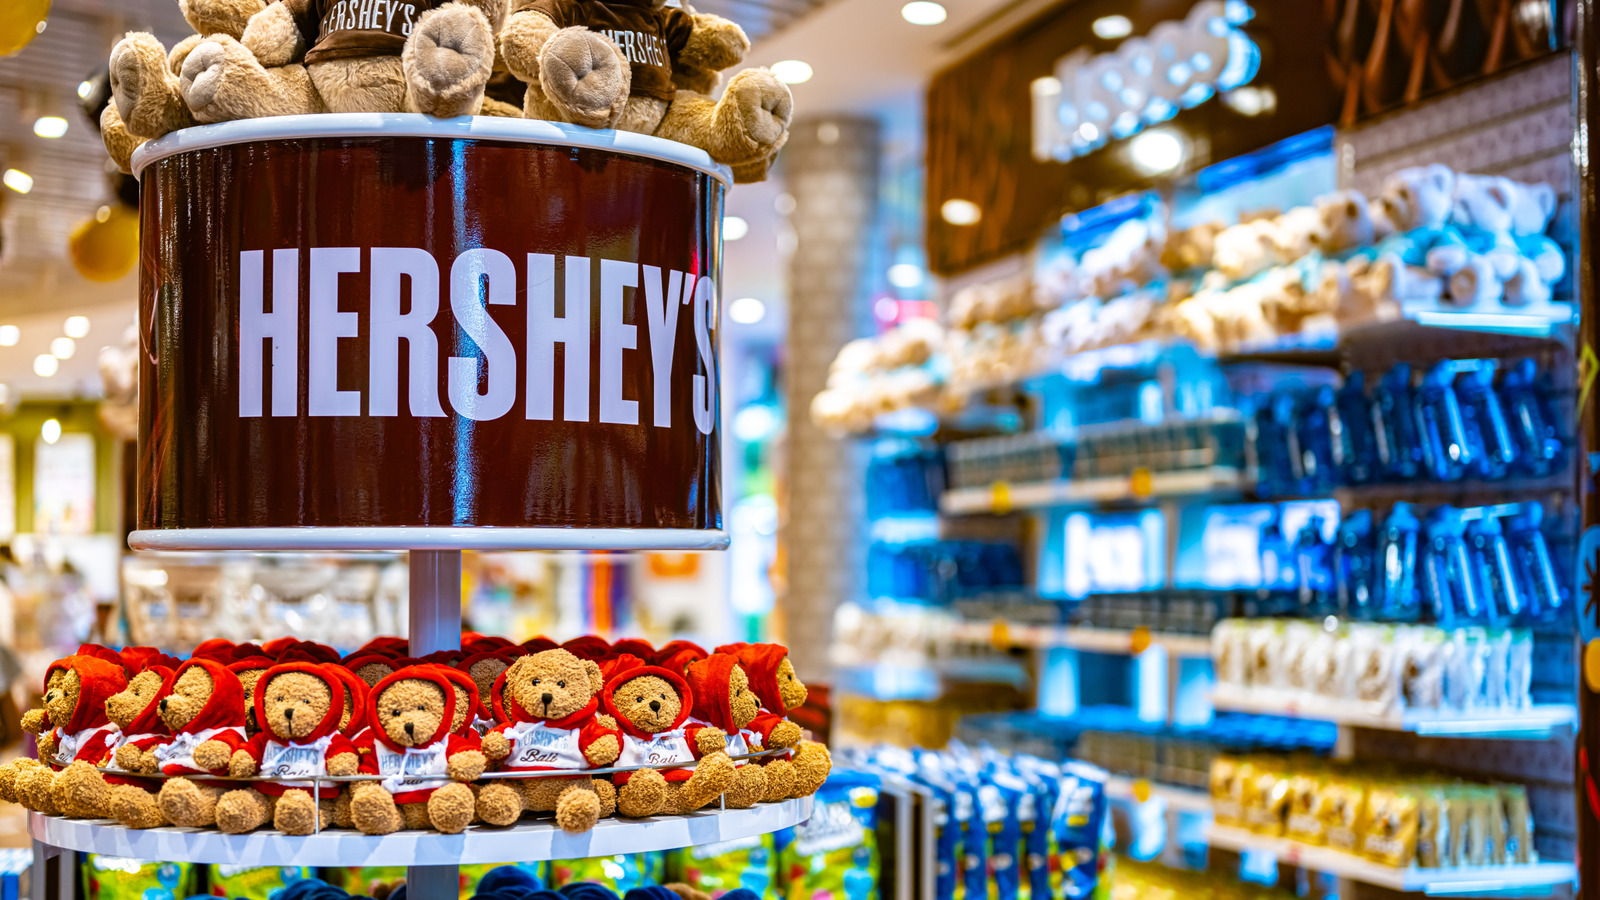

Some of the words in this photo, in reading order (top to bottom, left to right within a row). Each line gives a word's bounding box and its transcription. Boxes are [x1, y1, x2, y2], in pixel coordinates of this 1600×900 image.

[239, 248, 715, 435] HERSHEY'S
[520, 749, 559, 763] Bali
[645, 753, 679, 765] Bali
